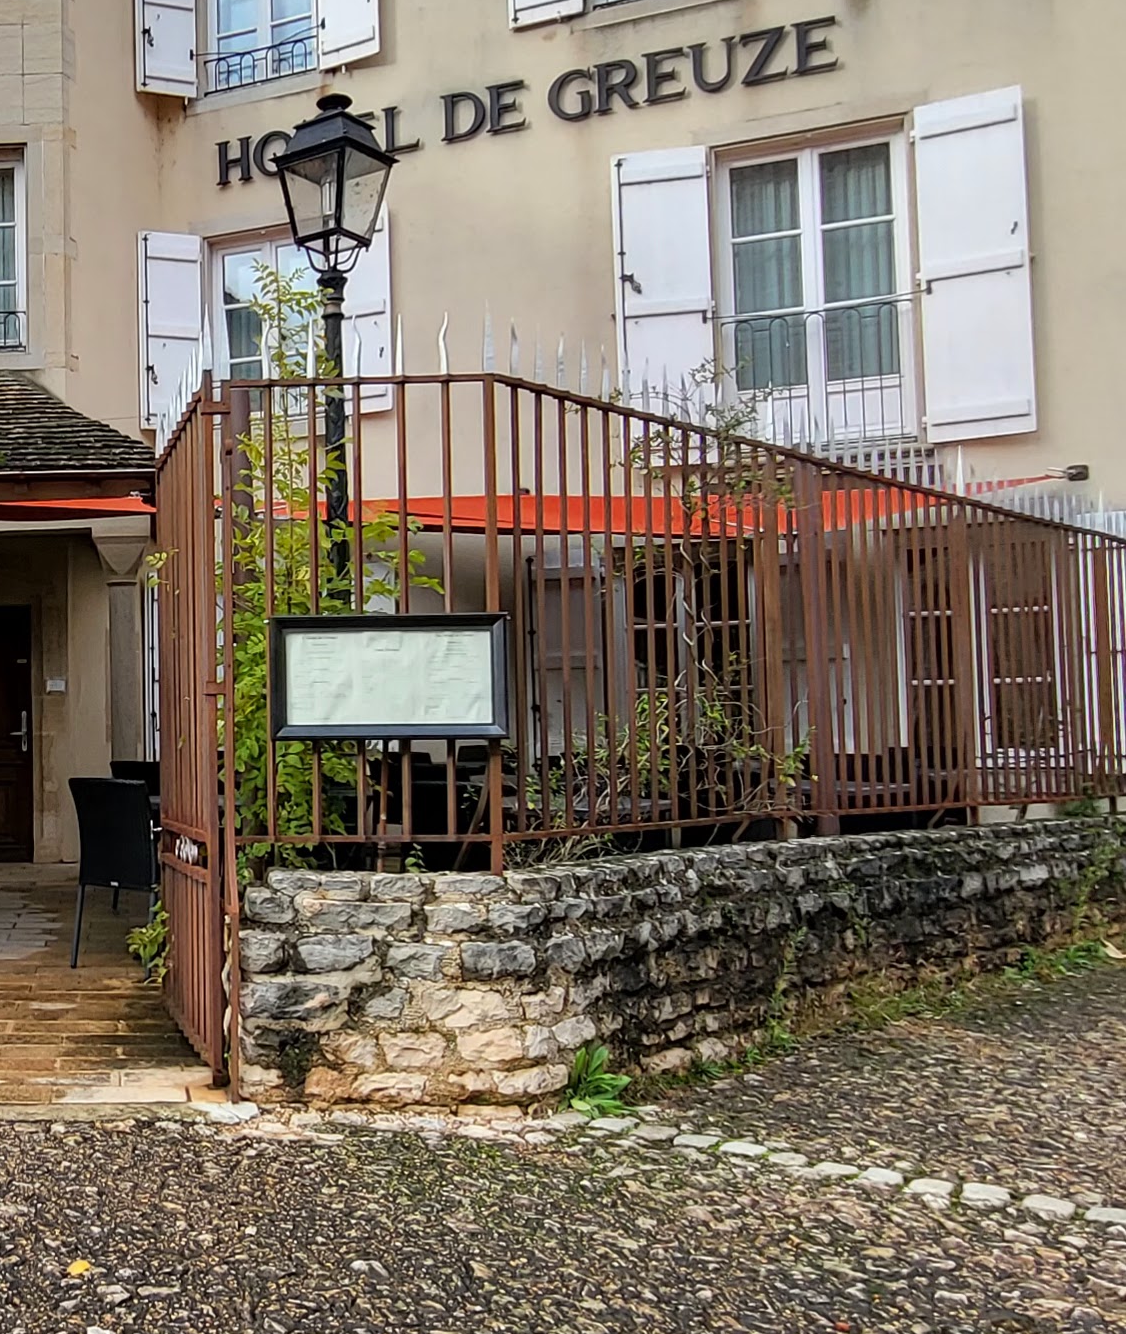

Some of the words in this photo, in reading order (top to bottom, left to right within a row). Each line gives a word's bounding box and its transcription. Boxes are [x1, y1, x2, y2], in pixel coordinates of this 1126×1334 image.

[215, 105, 421, 187] HOL
[439, 79, 528, 143] DE
[547, 15, 841, 123] GREUZE
